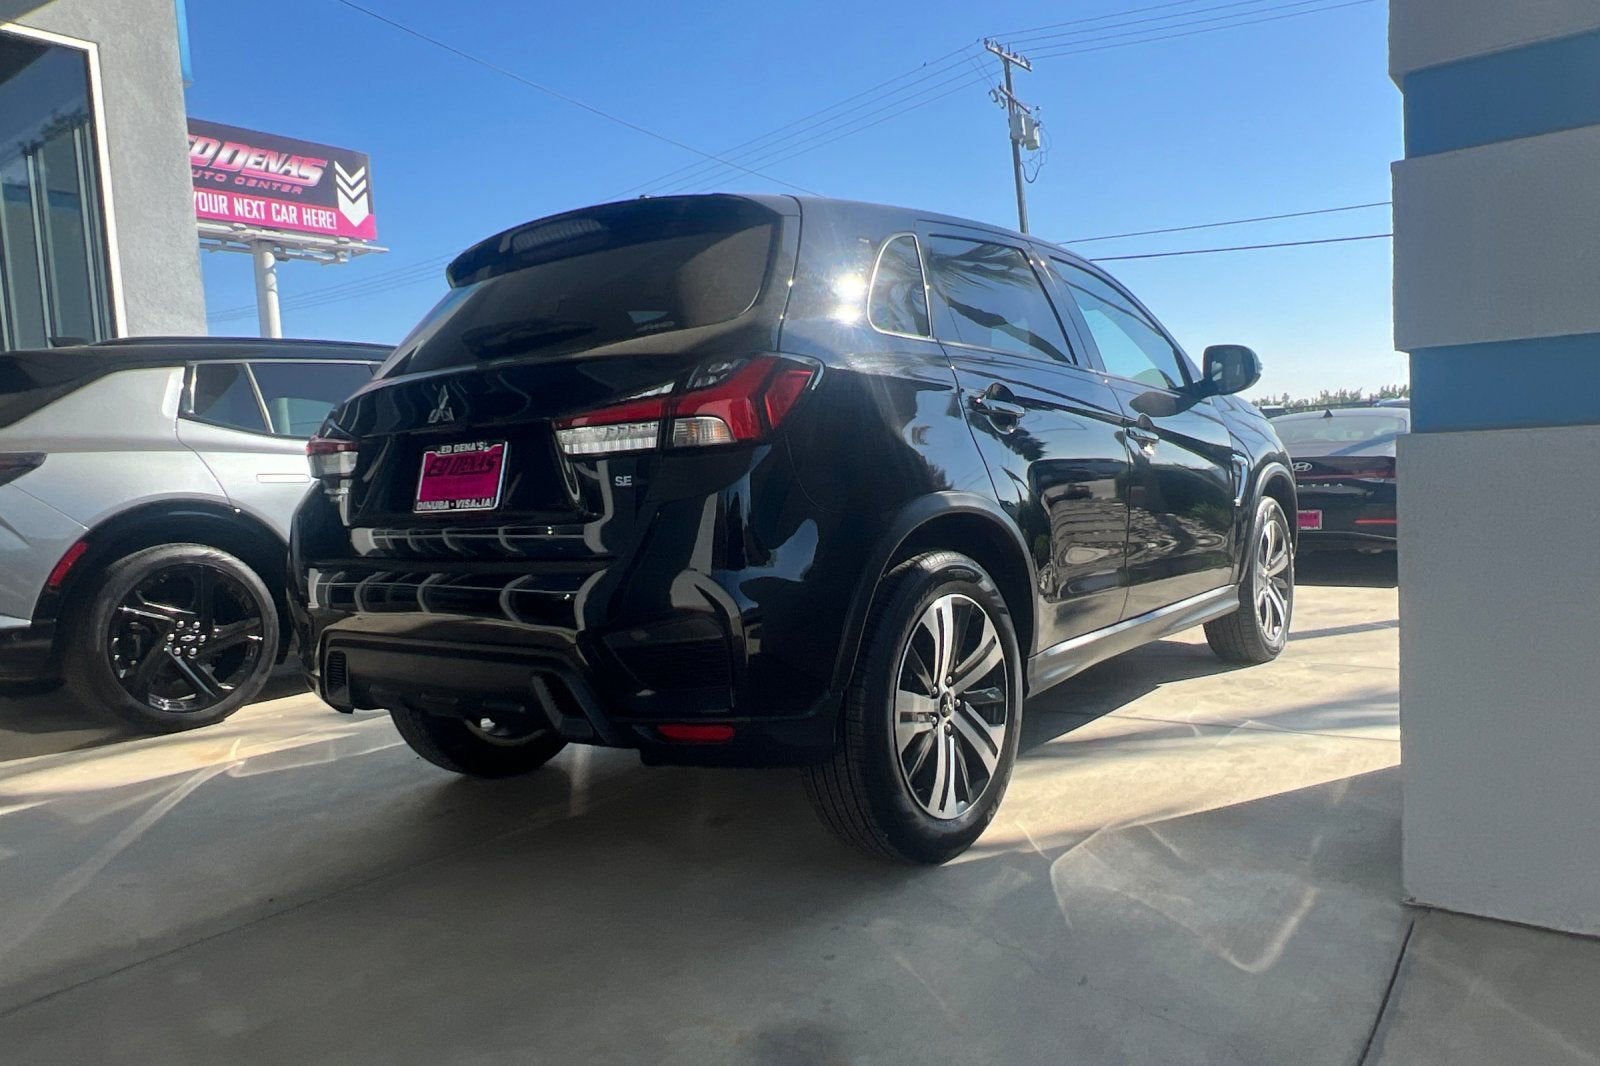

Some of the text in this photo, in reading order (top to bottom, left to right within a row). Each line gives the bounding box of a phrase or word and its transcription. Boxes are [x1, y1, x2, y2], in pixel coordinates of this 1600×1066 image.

[192, 169, 304, 195] UTO CENTER
[233, 197, 266, 220] NEXT
[271, 202, 299, 225] CAR
[302, 207, 338, 230] HERE!
[441, 445, 452, 454] ED
[615, 475, 632, 487] SE
